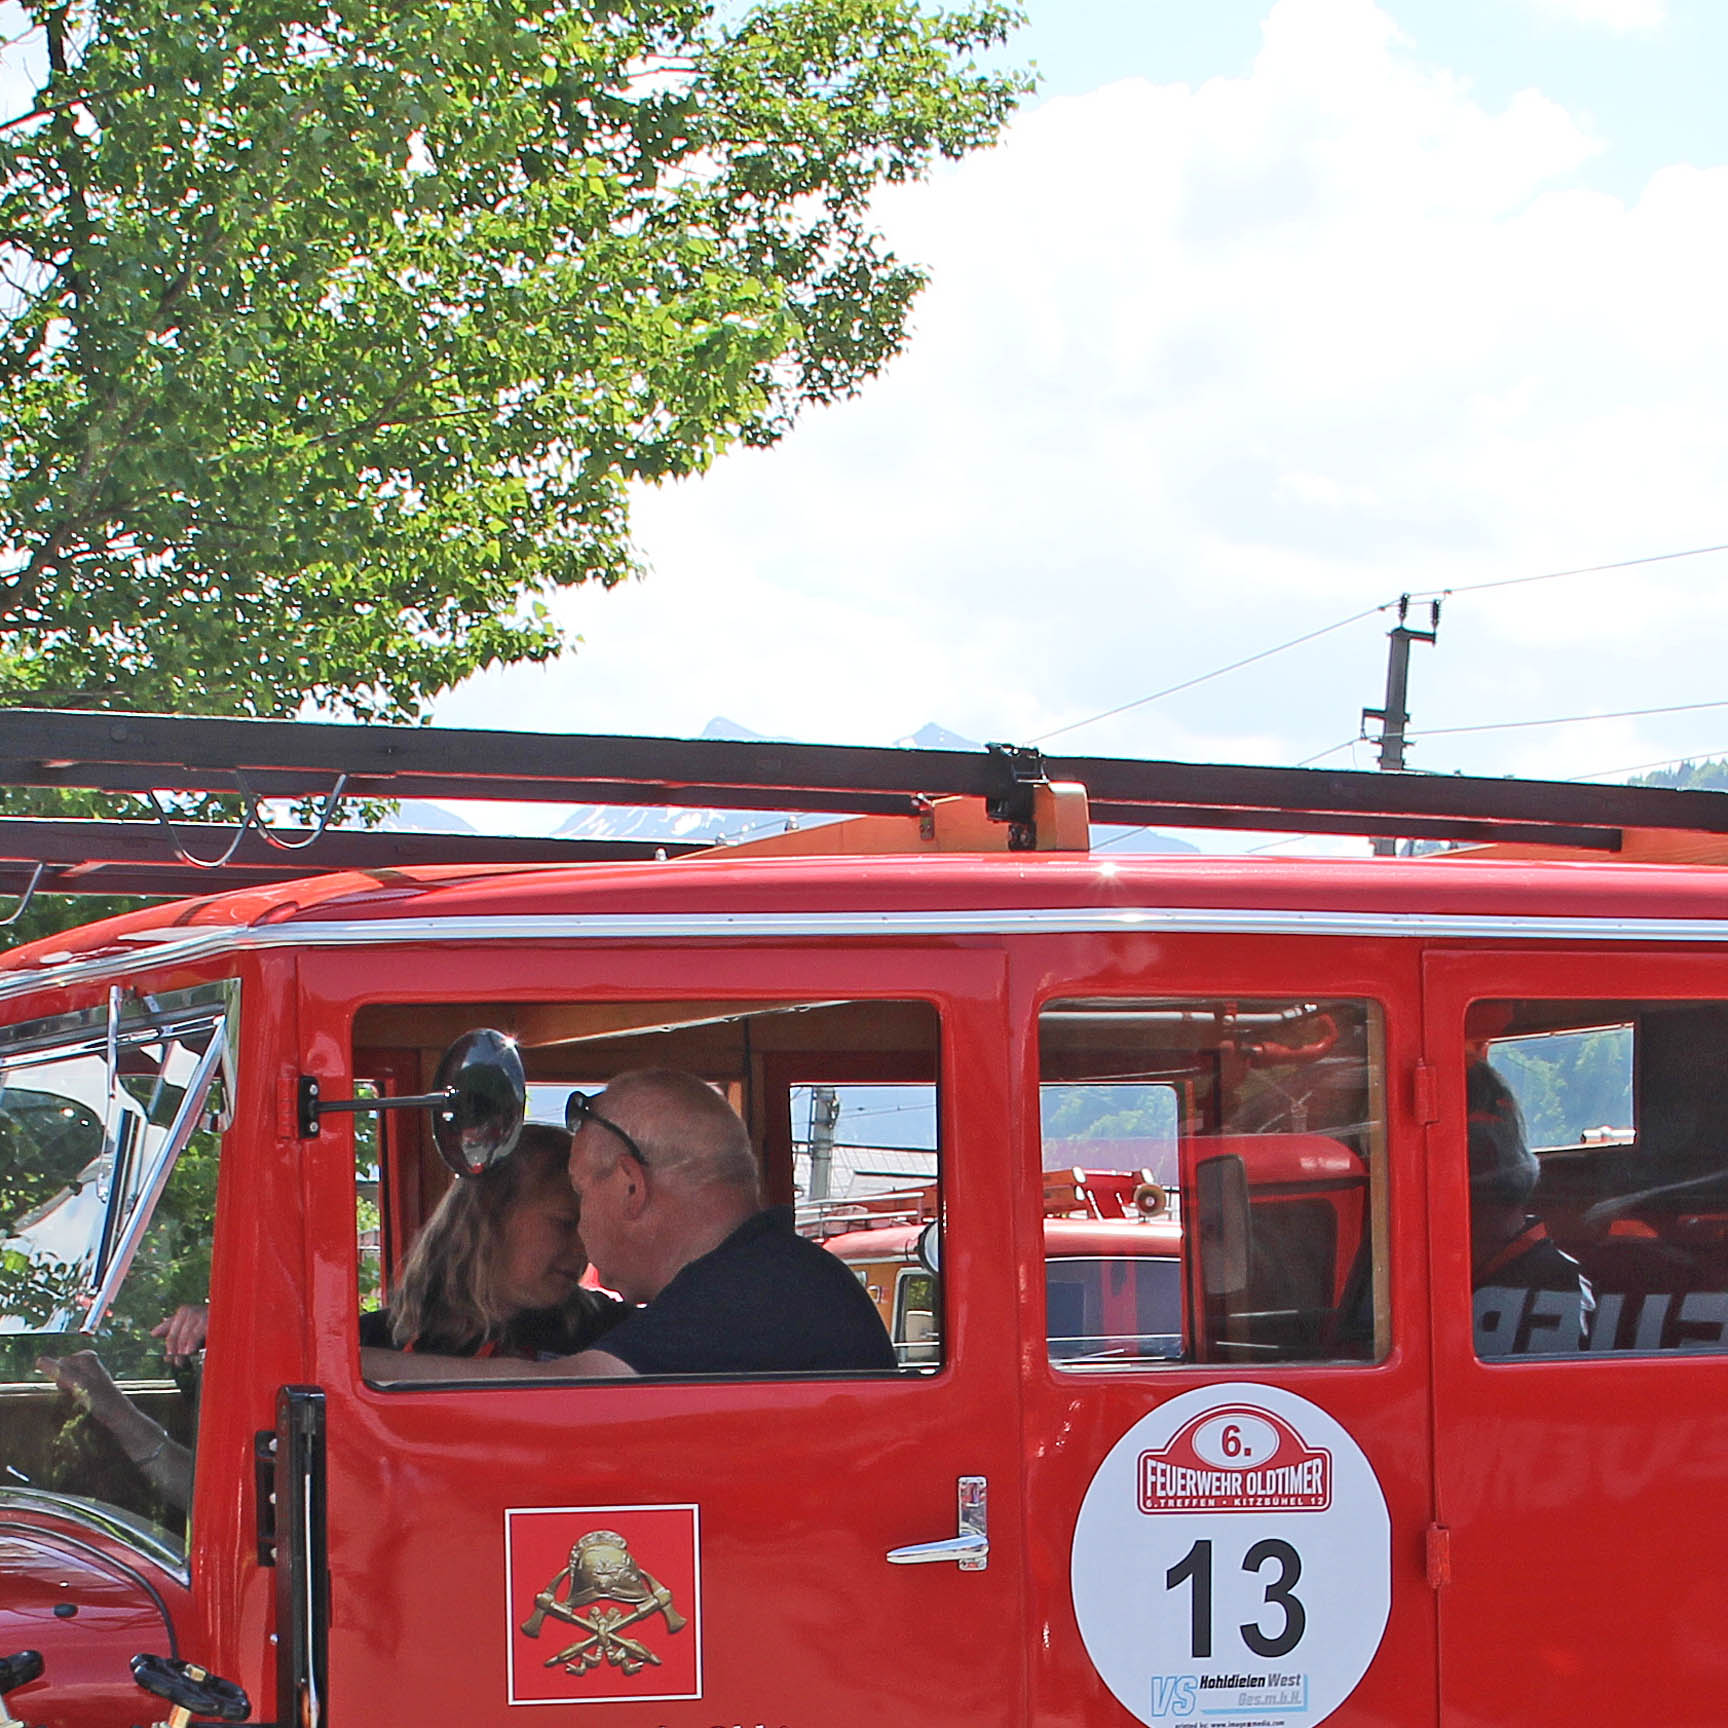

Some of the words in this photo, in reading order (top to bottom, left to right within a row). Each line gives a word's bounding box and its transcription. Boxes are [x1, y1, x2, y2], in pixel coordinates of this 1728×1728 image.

[1221, 1425, 1252, 1457] 6.
[1146, 1458, 1242, 1497] FEUERWEHR
[1246, 1458, 1323, 1495] OLDTIMER
[1166, 1538, 1306, 1658] 13
[1200, 1674, 1266, 1690] Hohldielen
[1267, 1672, 1302, 1688] West
